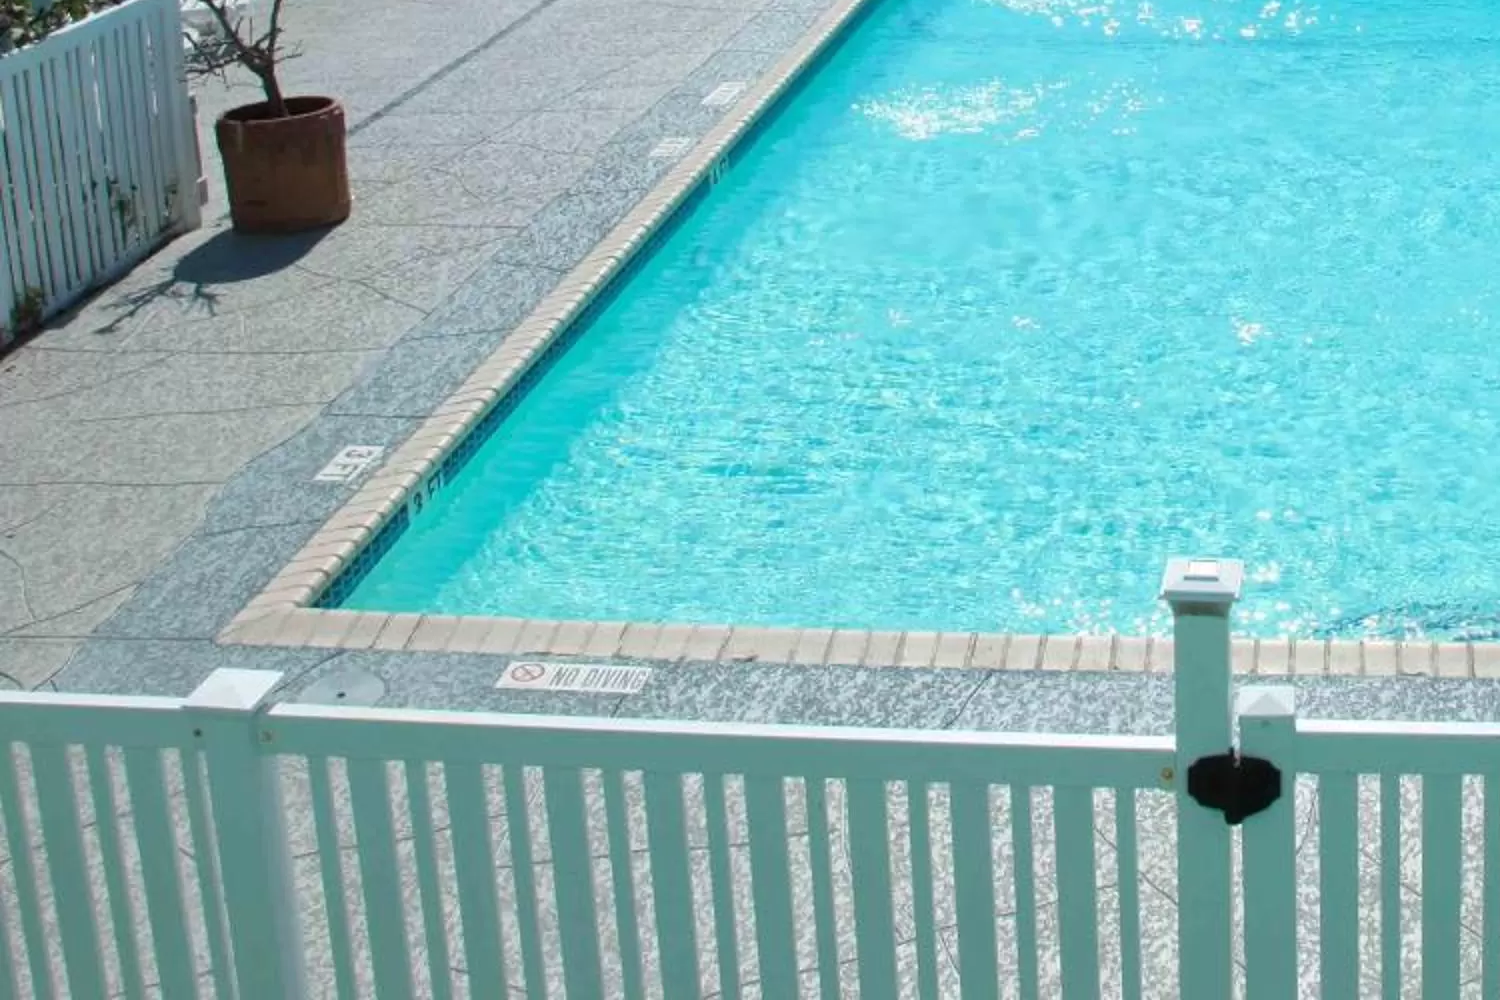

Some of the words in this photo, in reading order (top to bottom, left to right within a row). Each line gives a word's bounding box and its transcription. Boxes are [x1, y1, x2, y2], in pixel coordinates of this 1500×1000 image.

[413, 491, 424, 515] 3
[426, 470, 442, 500] FT
[548, 665, 581, 688] NO
[582, 667, 648, 690] DIVING
